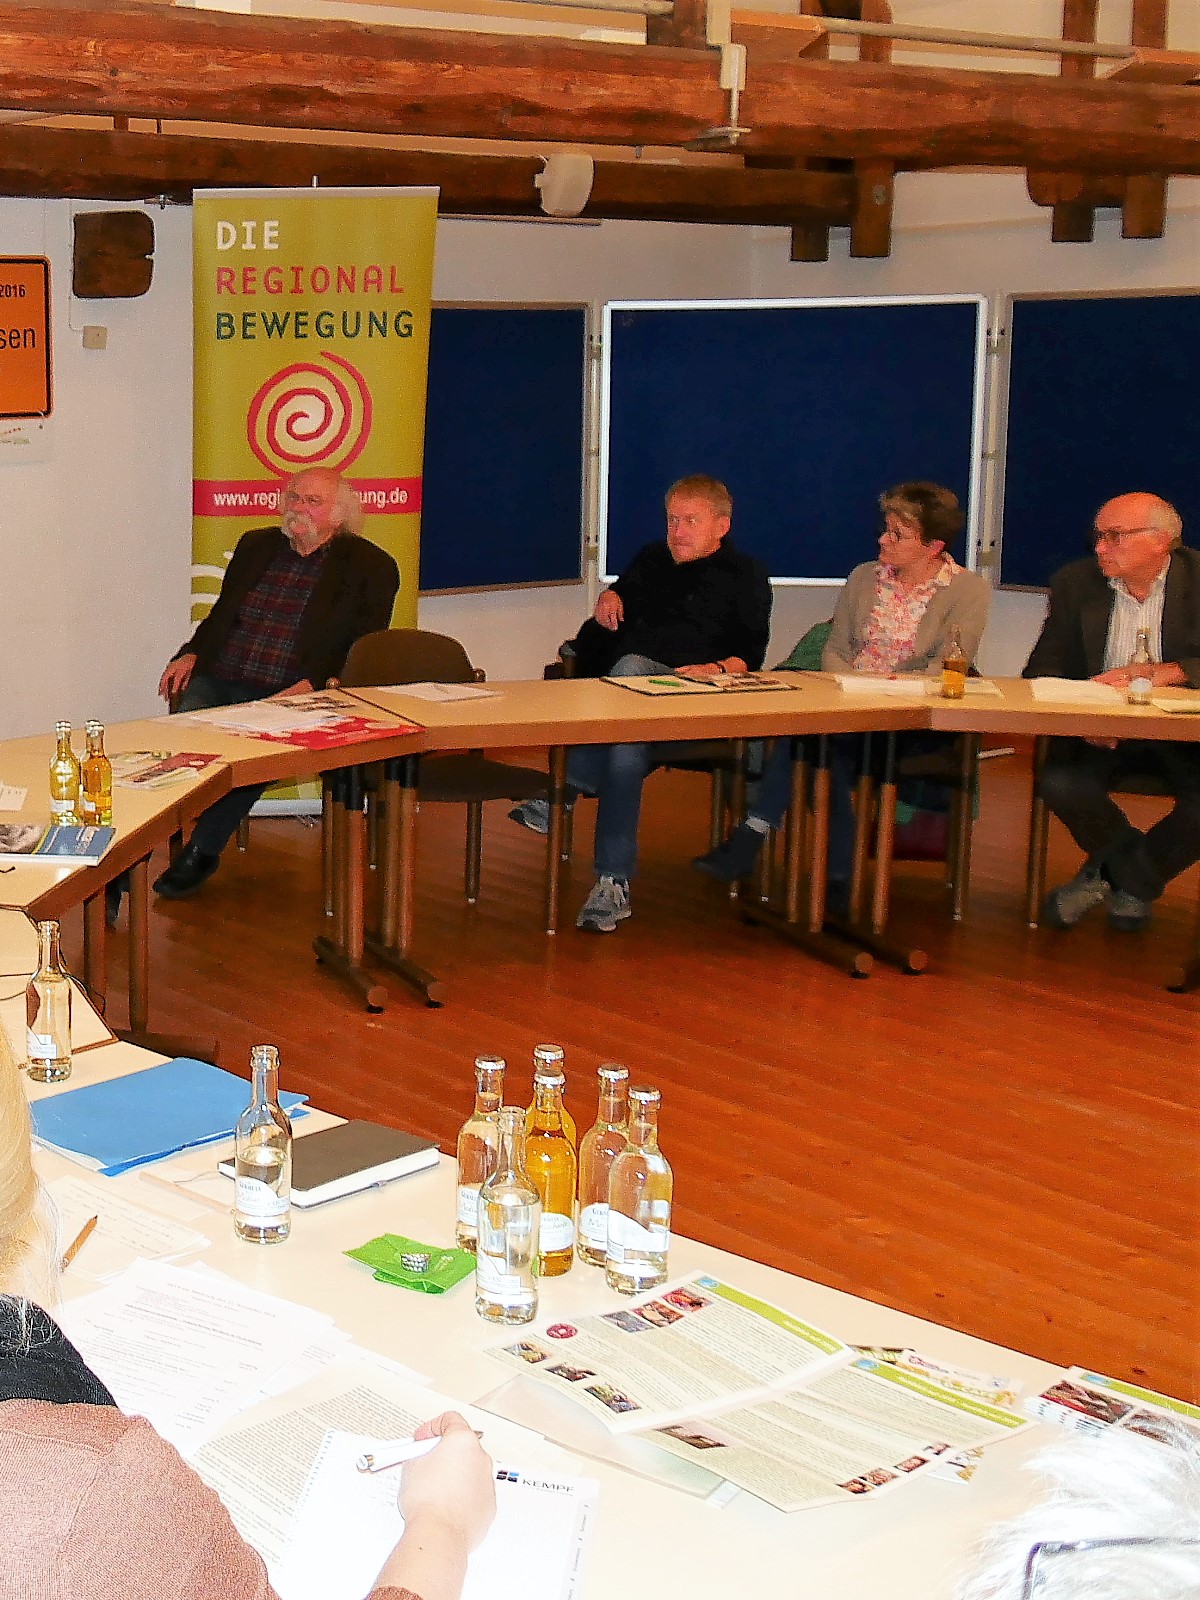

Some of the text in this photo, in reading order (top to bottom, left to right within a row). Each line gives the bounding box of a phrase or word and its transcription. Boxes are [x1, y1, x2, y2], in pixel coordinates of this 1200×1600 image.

[216, 219, 280, 250] DIE
[216, 265, 405, 295] REGIONAL
[216, 310, 414, 340] BEWEGUNG
[522, 1478, 576, 1493] KEMPF
